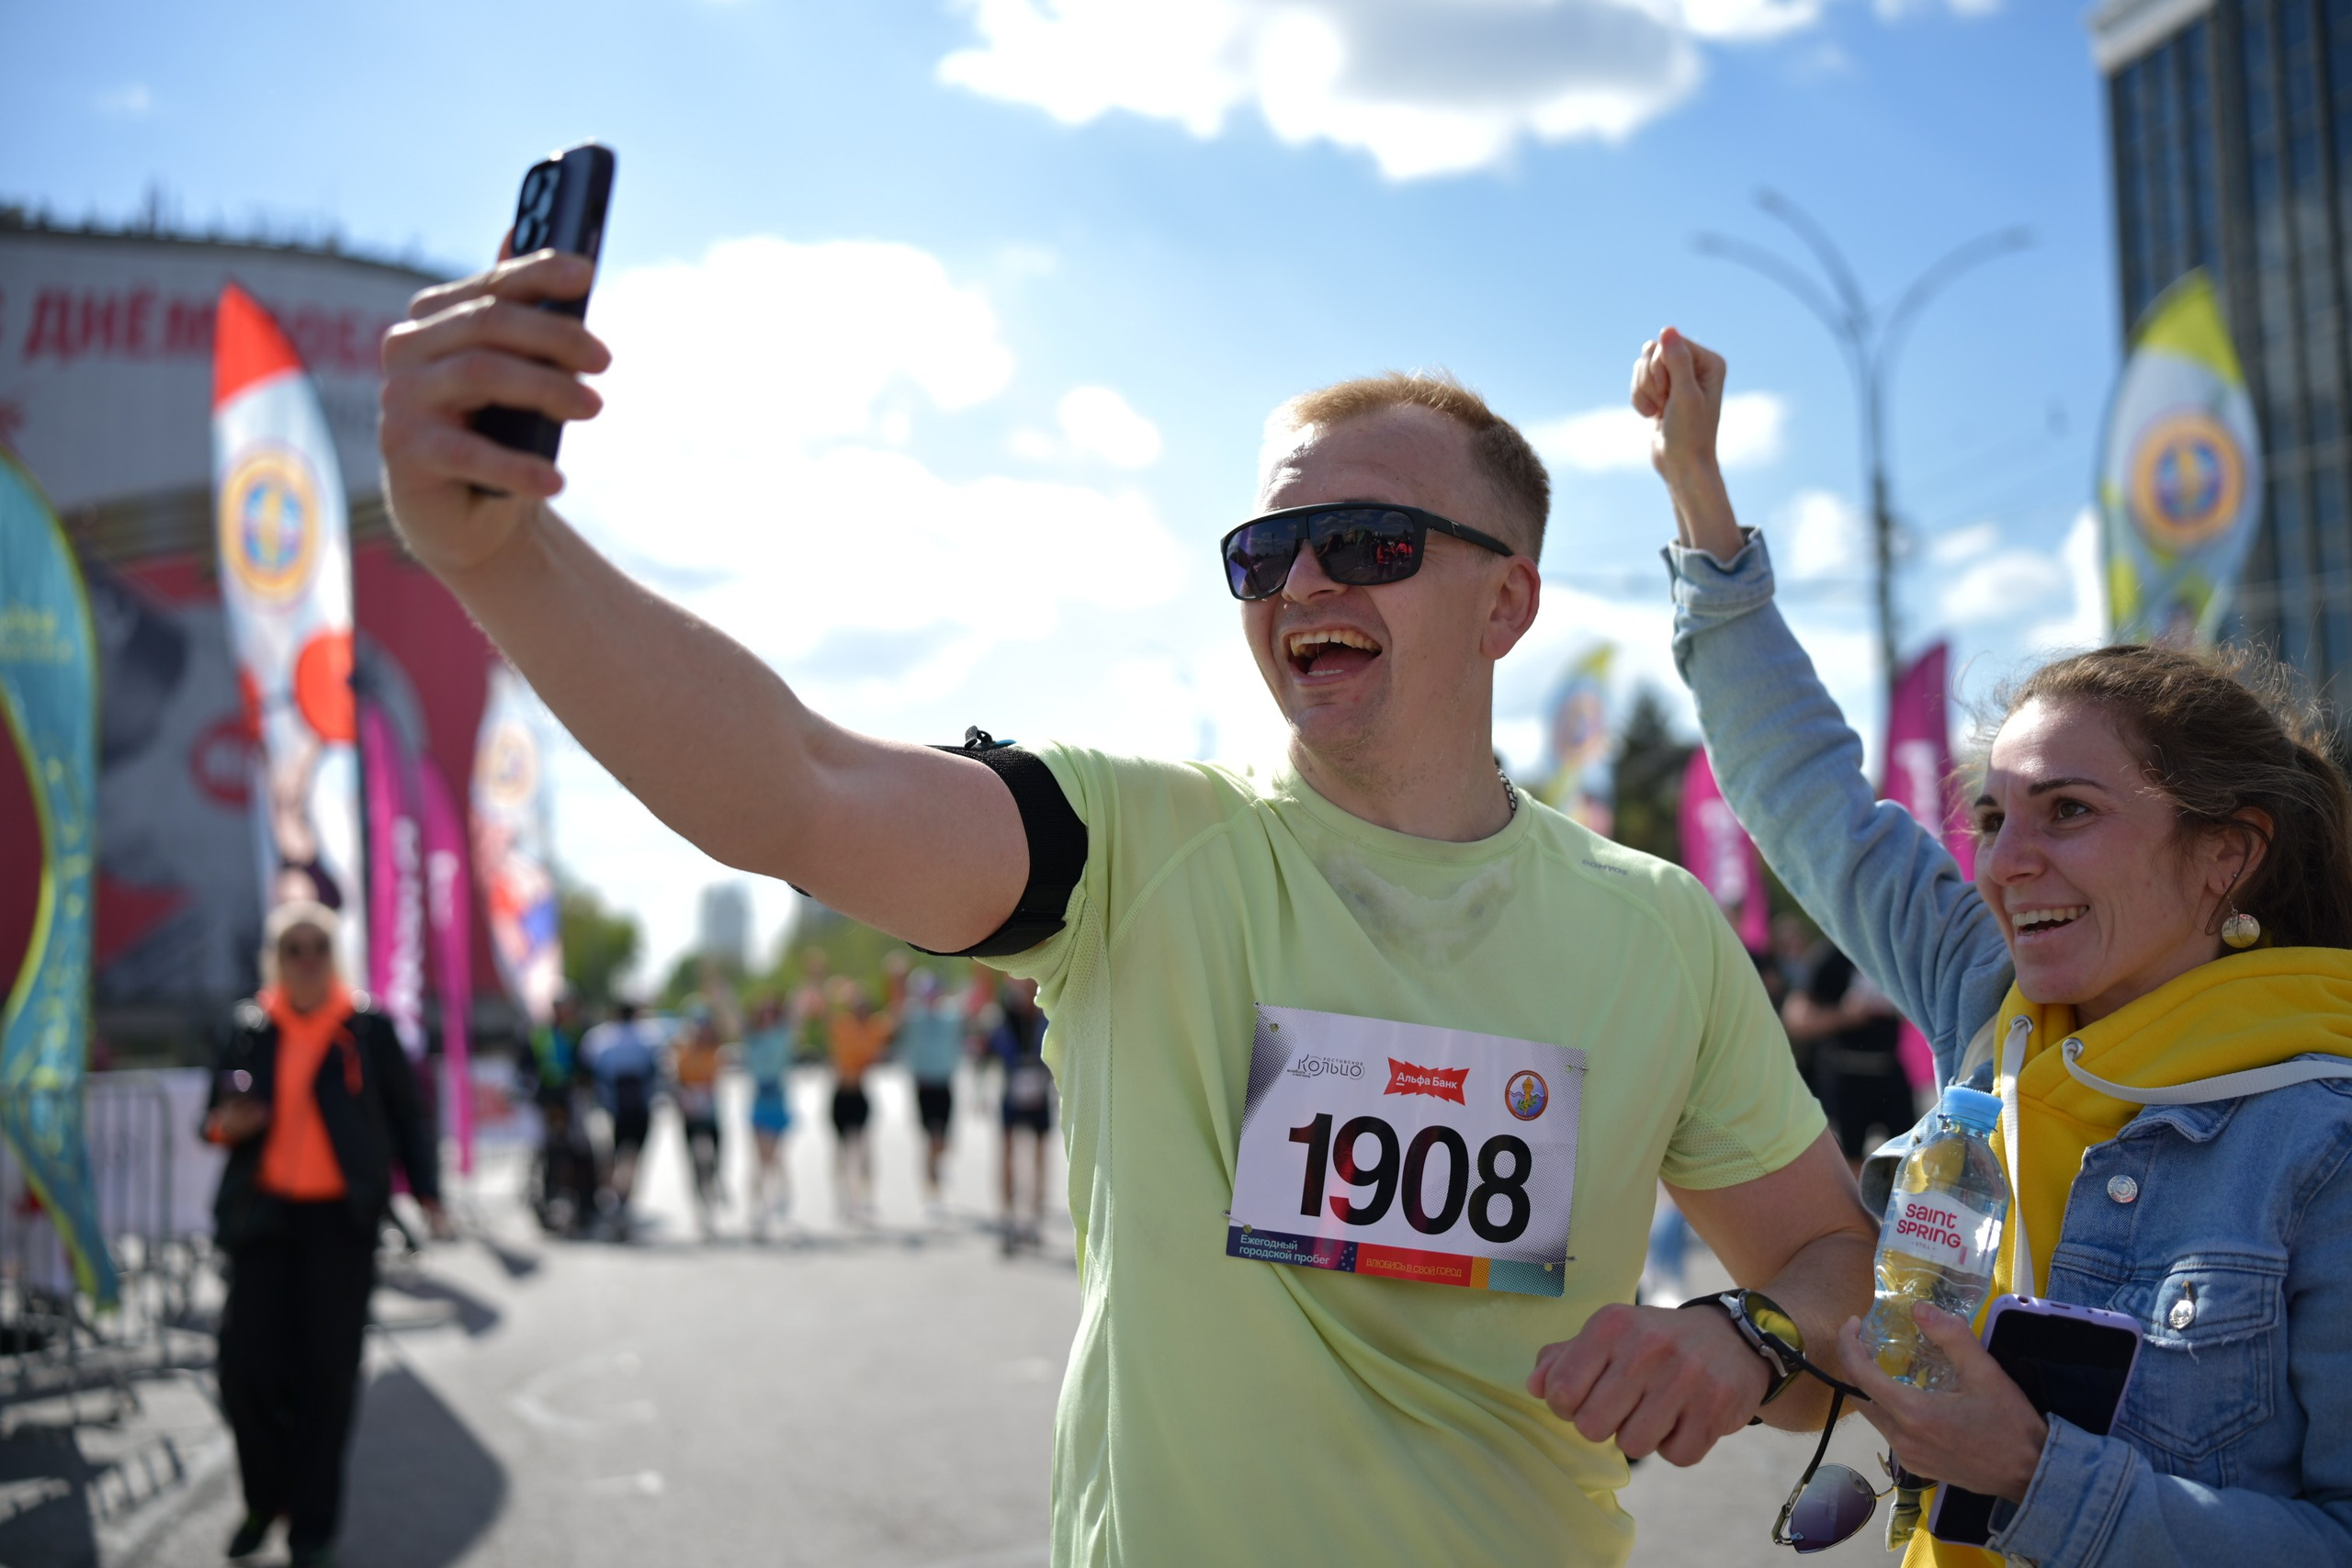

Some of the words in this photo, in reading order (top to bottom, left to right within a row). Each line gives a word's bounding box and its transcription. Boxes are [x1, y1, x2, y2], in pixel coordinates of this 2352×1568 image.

[1323, 1057, 1363, 1066] РОСТОВСКОЕ
[1396, 1072, 1430, 1087] Альфа
[1432, 1077, 1457, 1089] Банк
[1288, 1112, 1532, 1244] 1908
[1240, 1234, 1298, 1250] Ежегодный
[1238, 1247, 1292, 1260] городской
[1294, 1254, 1330, 1265] пробег
[1366, 1258, 1406, 1270] ВЛЮБИСЬ
[1407, 1264, 1413, 1272] В
[1413, 1265, 1435, 1275] СВОЙ
[1436, 1266, 1463, 1278] ГОРОД
